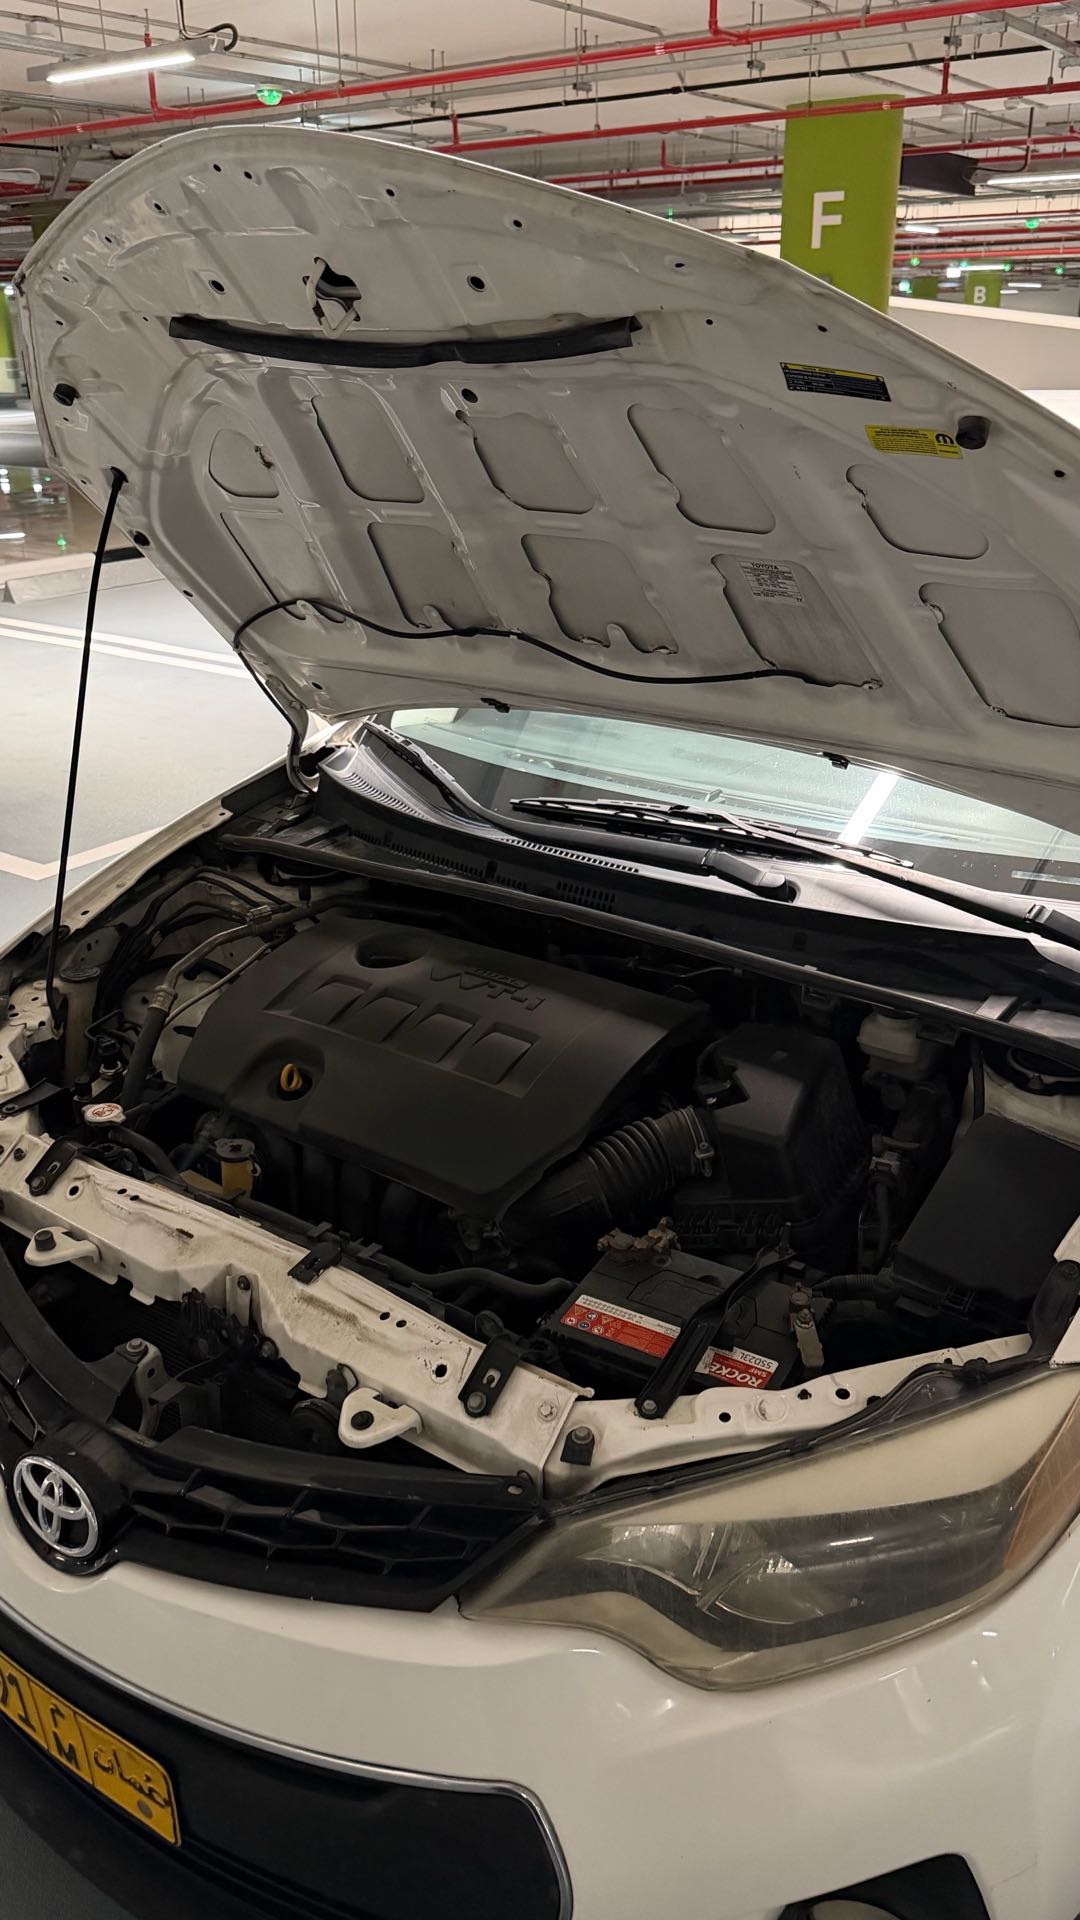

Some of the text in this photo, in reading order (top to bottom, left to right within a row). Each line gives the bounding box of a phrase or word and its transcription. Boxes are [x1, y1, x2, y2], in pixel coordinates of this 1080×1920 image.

[810, 190, 845, 250] F
[973, 285, 987, 305] B
[751, 562, 779, 570] TOYOTA
[739, 1352, 774, 1370] 55D23L
[709, 1361, 763, 1388] ROCKE
[53, 1729, 81, 1771] M
